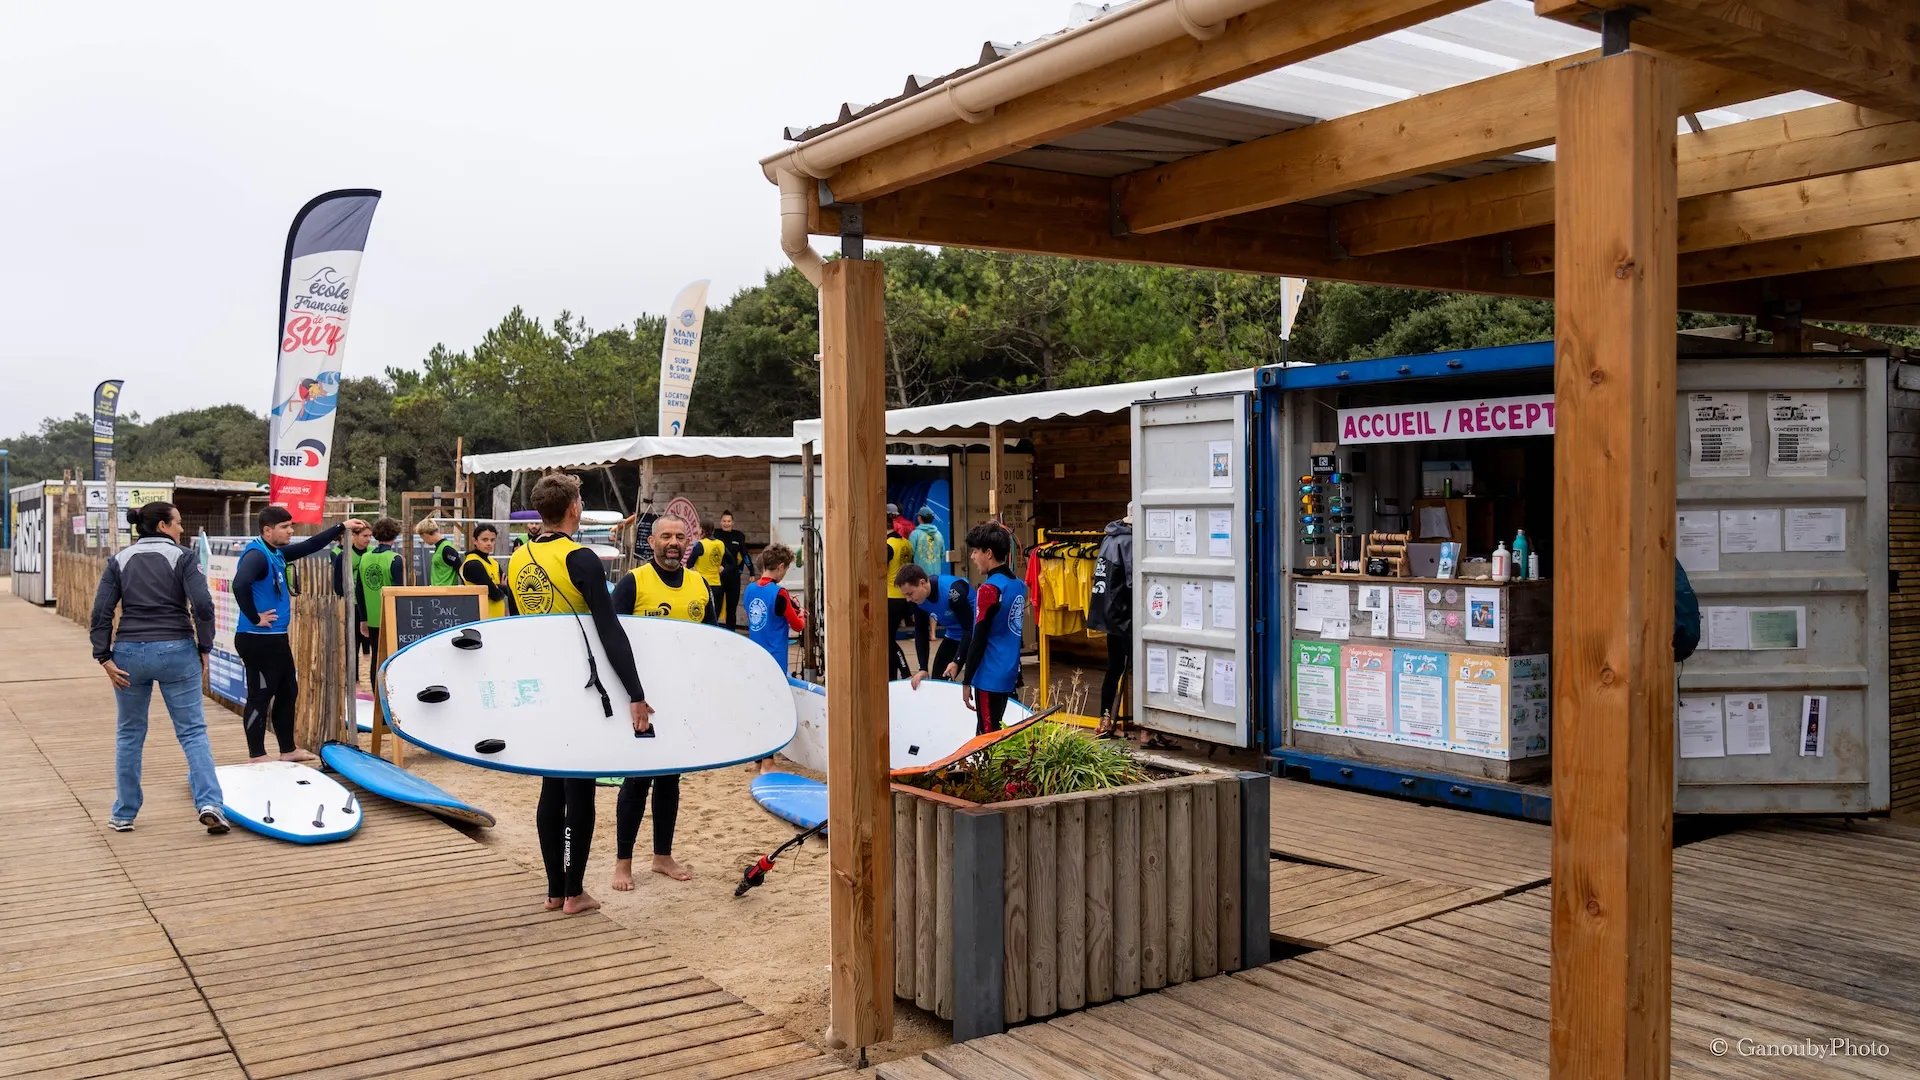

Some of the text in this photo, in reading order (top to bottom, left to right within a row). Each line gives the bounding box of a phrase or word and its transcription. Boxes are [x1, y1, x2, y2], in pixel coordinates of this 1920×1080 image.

[309, 279, 350, 300] école
[312, 314, 323, 324] de
[282, 316, 345, 356] Surf
[673, 328, 698, 339] MANU
[673, 337, 695, 347] SURF
[669, 372, 691, 381] SCHOOL
[1343, 402, 1555, 439] ACCUEIL / RÉCEPT
[517, 566, 550, 591] MANU SURF
[431, 598, 459, 617] BANC
[410, 619, 425, 629] DE
